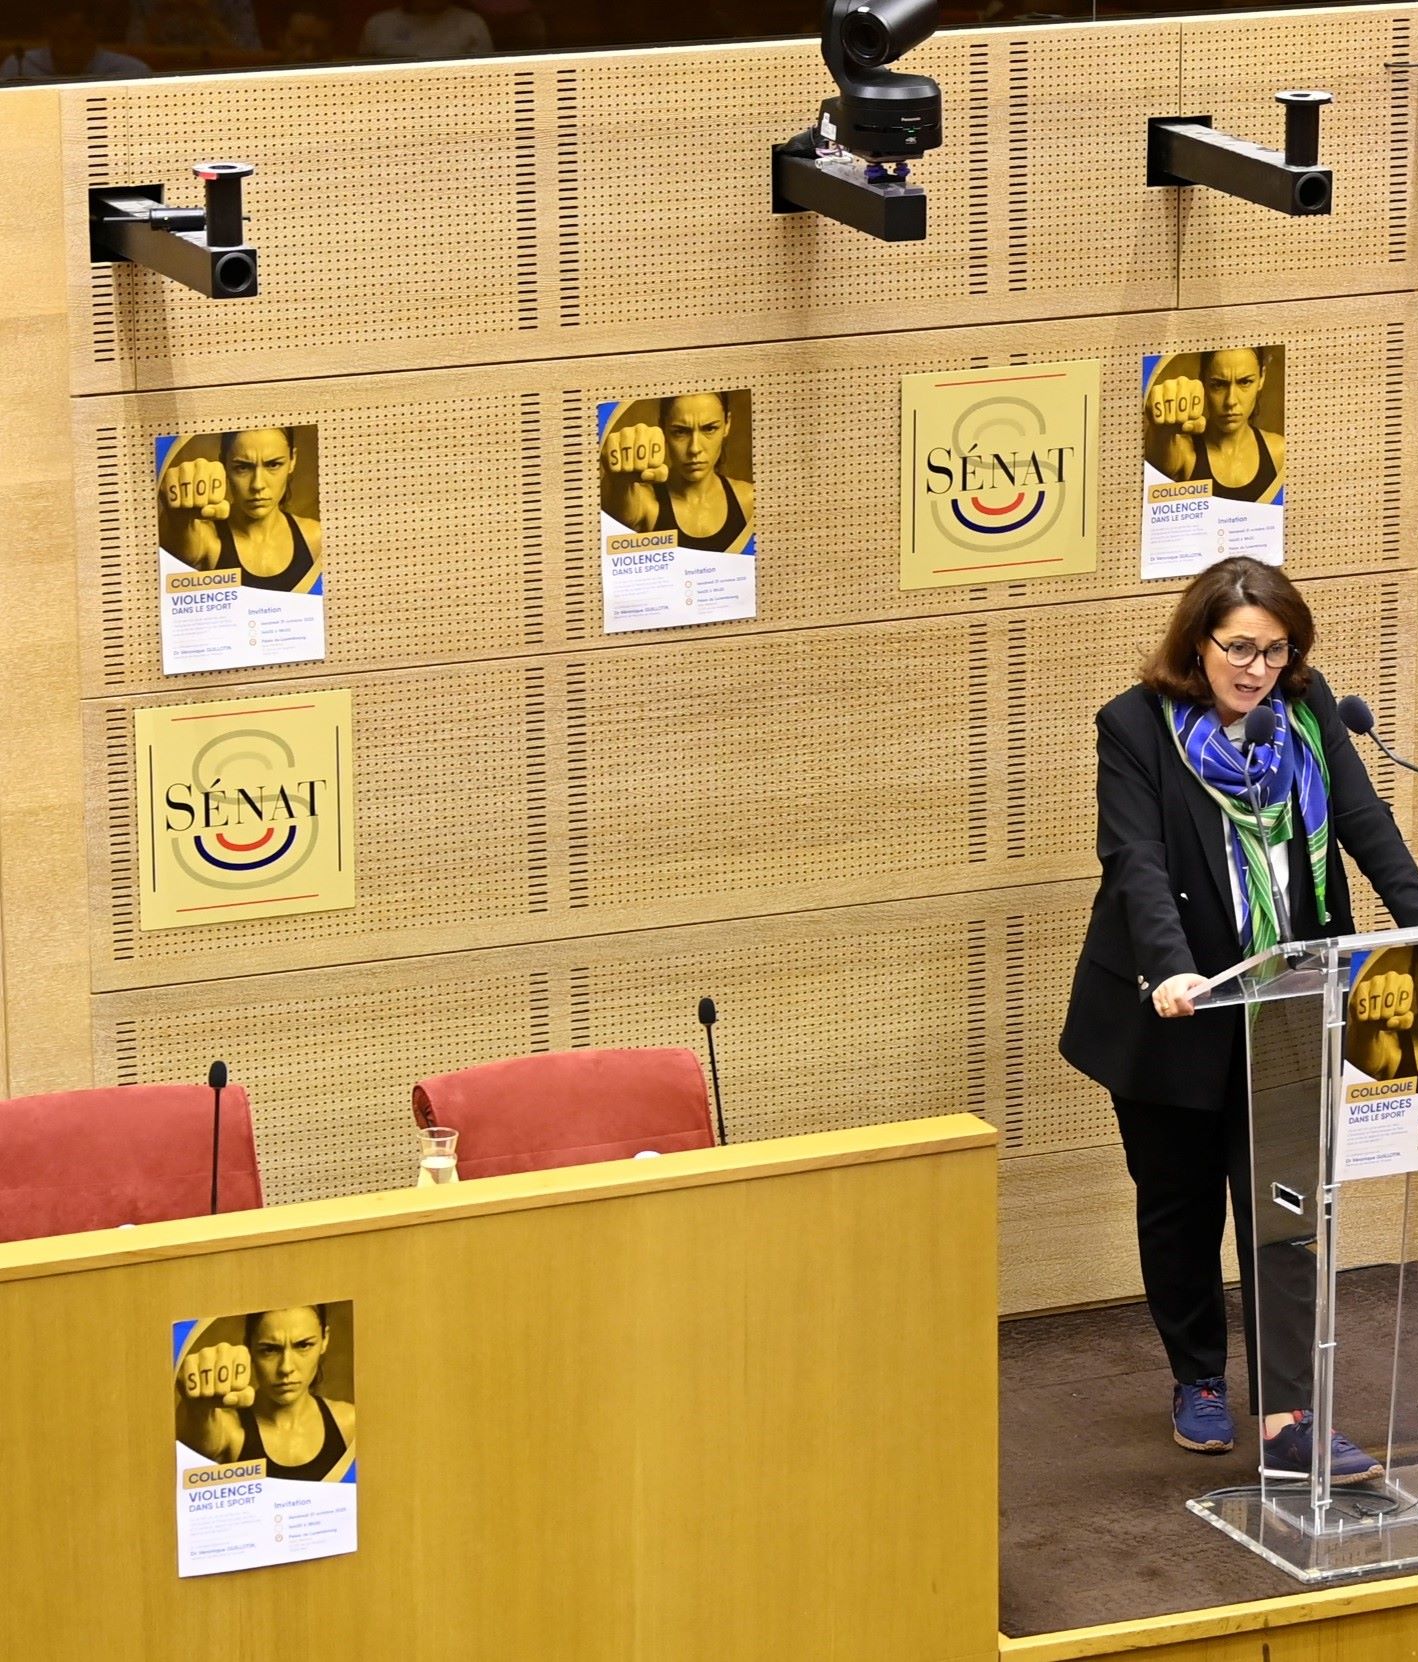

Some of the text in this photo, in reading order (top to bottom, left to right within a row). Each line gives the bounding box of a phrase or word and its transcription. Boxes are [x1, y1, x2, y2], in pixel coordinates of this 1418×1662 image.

[1154, 395, 1201, 418] STOP
[610, 443, 661, 466] STOP
[926, 443, 1075, 495] SÉNAT
[169, 478, 223, 501] STOP
[1151, 484, 1209, 499] COLLOQUE
[1151, 501, 1209, 515] VIOLENCES
[1151, 516, 1170, 524] DANS
[1181, 512, 1204, 521] SPORT
[611, 534, 674, 550] COLLOQUE
[611, 551, 675, 567] VIOLENCES
[612, 568, 633, 576] DANS
[644, 564, 669, 573] SPORT
[171, 573, 237, 589] COLLOQUE
[171, 591, 238, 606] VIOLENCES
[172, 602, 232, 615] DANS LE SPORT
[165, 778, 327, 832] SÉNAT
[1359, 990, 1409, 1015] STOP
[1350, 1081, 1413, 1099] COLLOQUE
[1350, 1098, 1412, 1115] VIOLENCES
[1348, 1110, 1406, 1124] DANS LE SPORT
[187, 1363, 246, 1391] STOP
[188, 1464, 262, 1484] COLLOQUE
[188, 1483, 263, 1503] VIOLENCES
[189, 1496, 256, 1513] DANS LE SPORT
